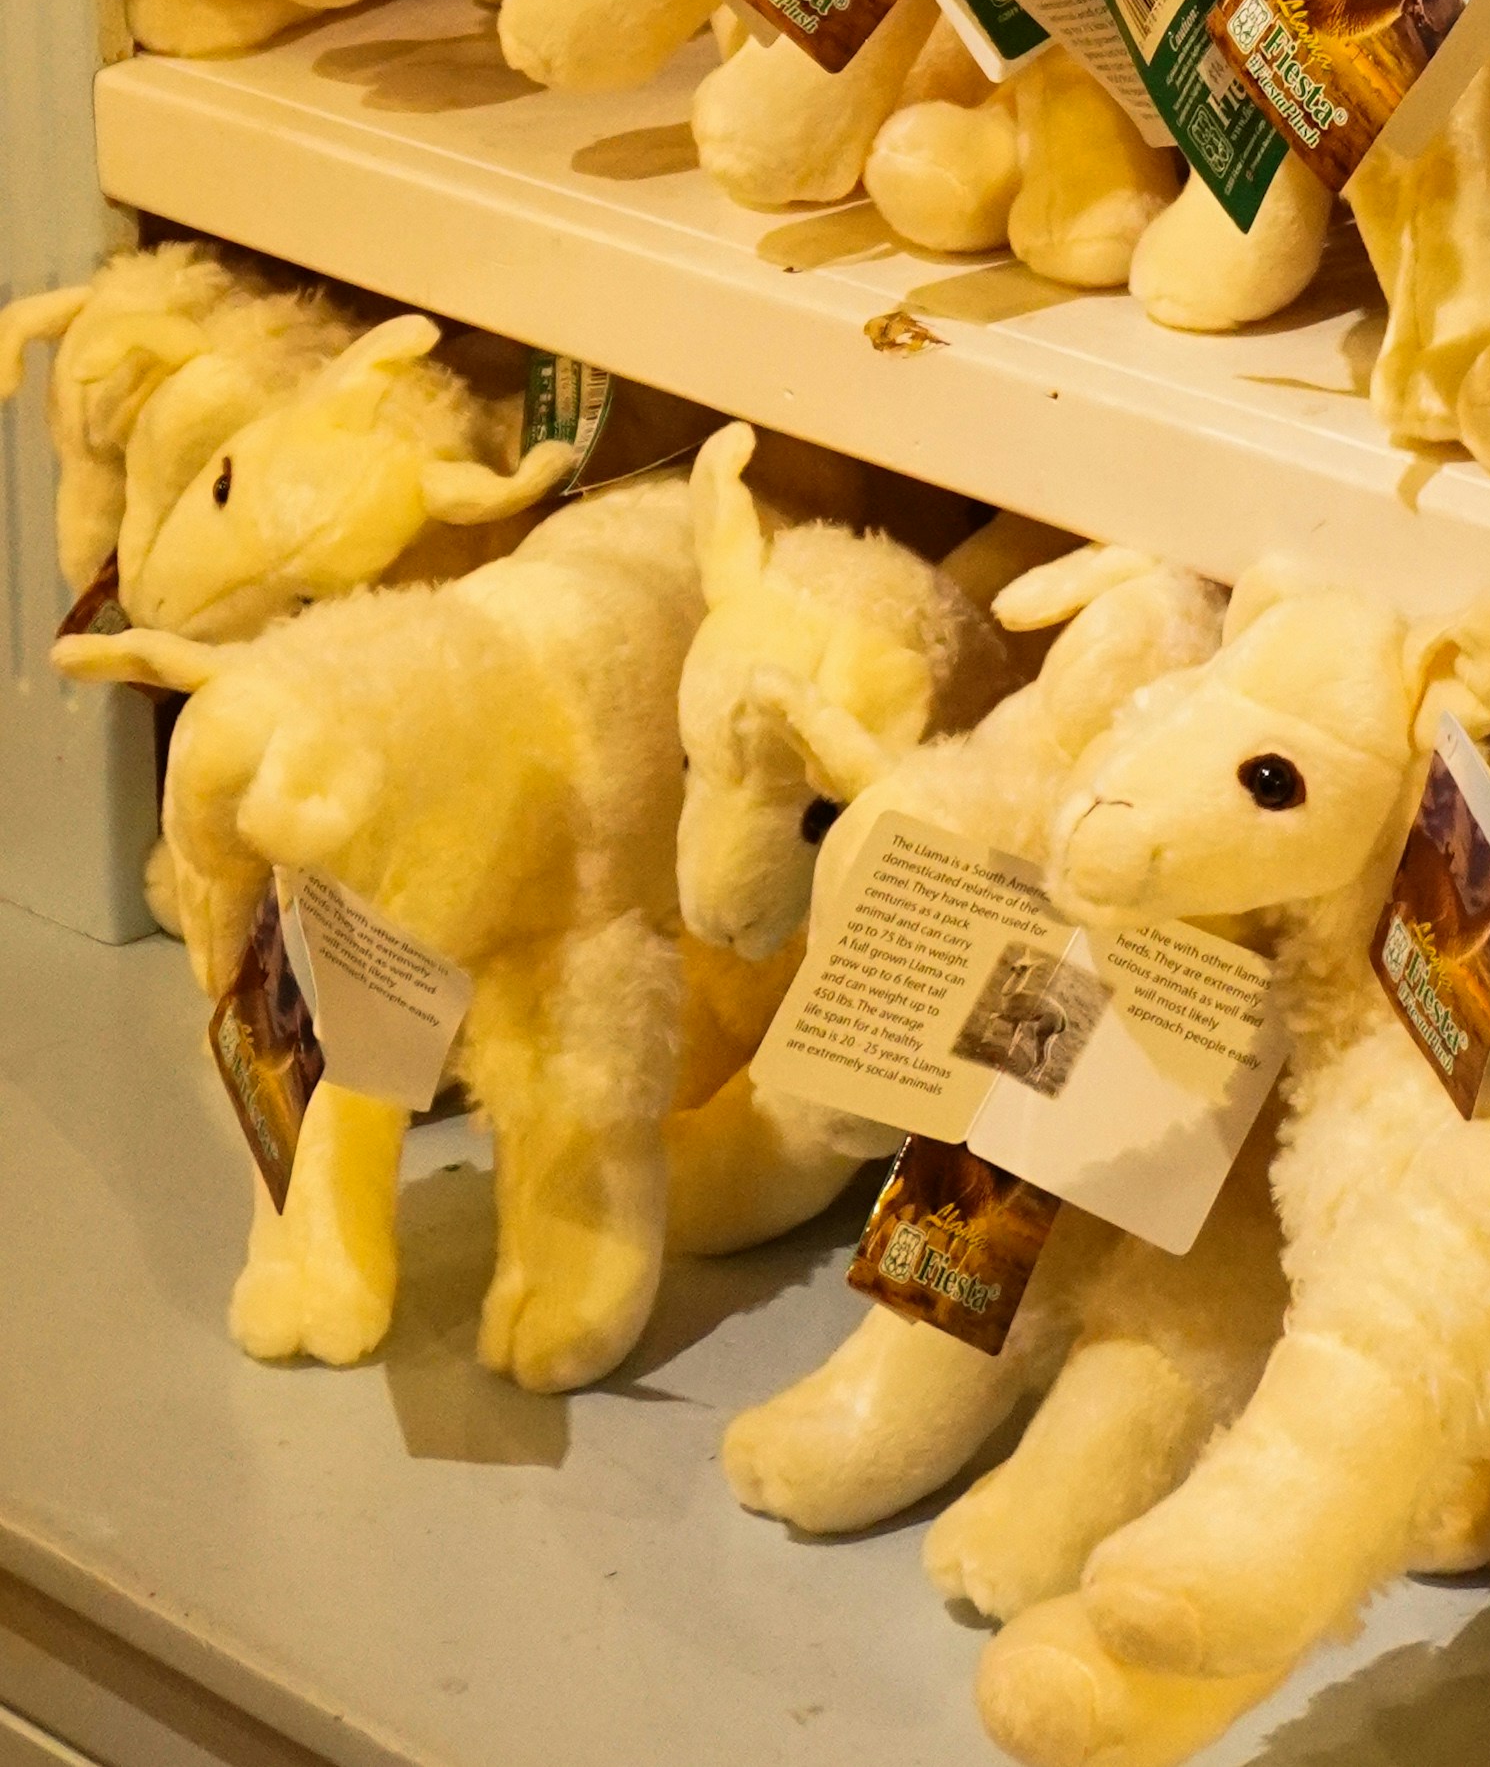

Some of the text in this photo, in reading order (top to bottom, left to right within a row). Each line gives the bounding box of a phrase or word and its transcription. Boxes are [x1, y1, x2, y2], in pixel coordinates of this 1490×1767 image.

[1246, 52, 1322, 148] #FiestaPlush
[880, 851, 1041, 917] domesticated relative of the
[891, 834, 914, 852] The
[913, 842, 951, 865] Llama
[949, 856, 961, 869] is
[971, 863, 1008, 885] South
[853, 901, 973, 952] animal and can carry
[862, 884, 919, 913] centuries
[917, 905, 933, 918] as
[940, 912, 971, 933] pack
[909, 881, 939, 902] They
[939, 891, 970, 911] have
[969, 901, 1001, 921] been
[1000, 912, 1031, 932] used
[1029, 922, 1050, 938] for
[844, 919, 864, 935] up
[864, 925, 879, 938] to
[878, 928, 895, 943] 75
[894, 934, 915, 950] lbs
[913, 940, 928, 954] in
[847, 937, 870, 955] full
[867, 946, 908, 970] grown
[907, 959, 944, 980] Llama
[943, 972, 966, 988] can
[1149, 928, 1173, 946] live
[1171, 938, 1200, 958] with
[1199, 950, 1234, 973] other
[1232, 964, 1274, 991] llamas
[819, 967, 941, 1018] and can weight up to
[827, 952, 861, 974] grow
[859, 964, 878, 980] up
[878, 968, 894, 982] to
[901, 975, 927, 994] feet
[926, 984, 948, 1000] tall
[1105, 950, 1265, 1029] curious animals as well and
[1114, 932, 1155, 960] herds.
[1149, 949, 1183, 975] They
[1181, 965, 1203, 981] are
[1200, 972, 1262, 1009] extremely
[801, 1001, 823, 1018] life
[820, 1010, 852, 1030] span
[851, 1018, 871, 1034] for
[878, 1026, 925, 1054] healthy
[811, 984, 836, 1003] 450
[855, 999, 879, 1017] The
[877, 1008, 925, 1034] average
[1132, 982, 1221, 1033] will most likely
[793, 1018, 828, 1040] llama
[827, 1030, 839, 1043] is
[838, 1033, 856, 1048] 20
[862, 1041, 879, 1056] 25
[910, 1057, 953, 1081] Llamas
[1124, 1001, 1262, 1071] approach people easily
[784, 1036, 945, 1098] are extremely social animals
